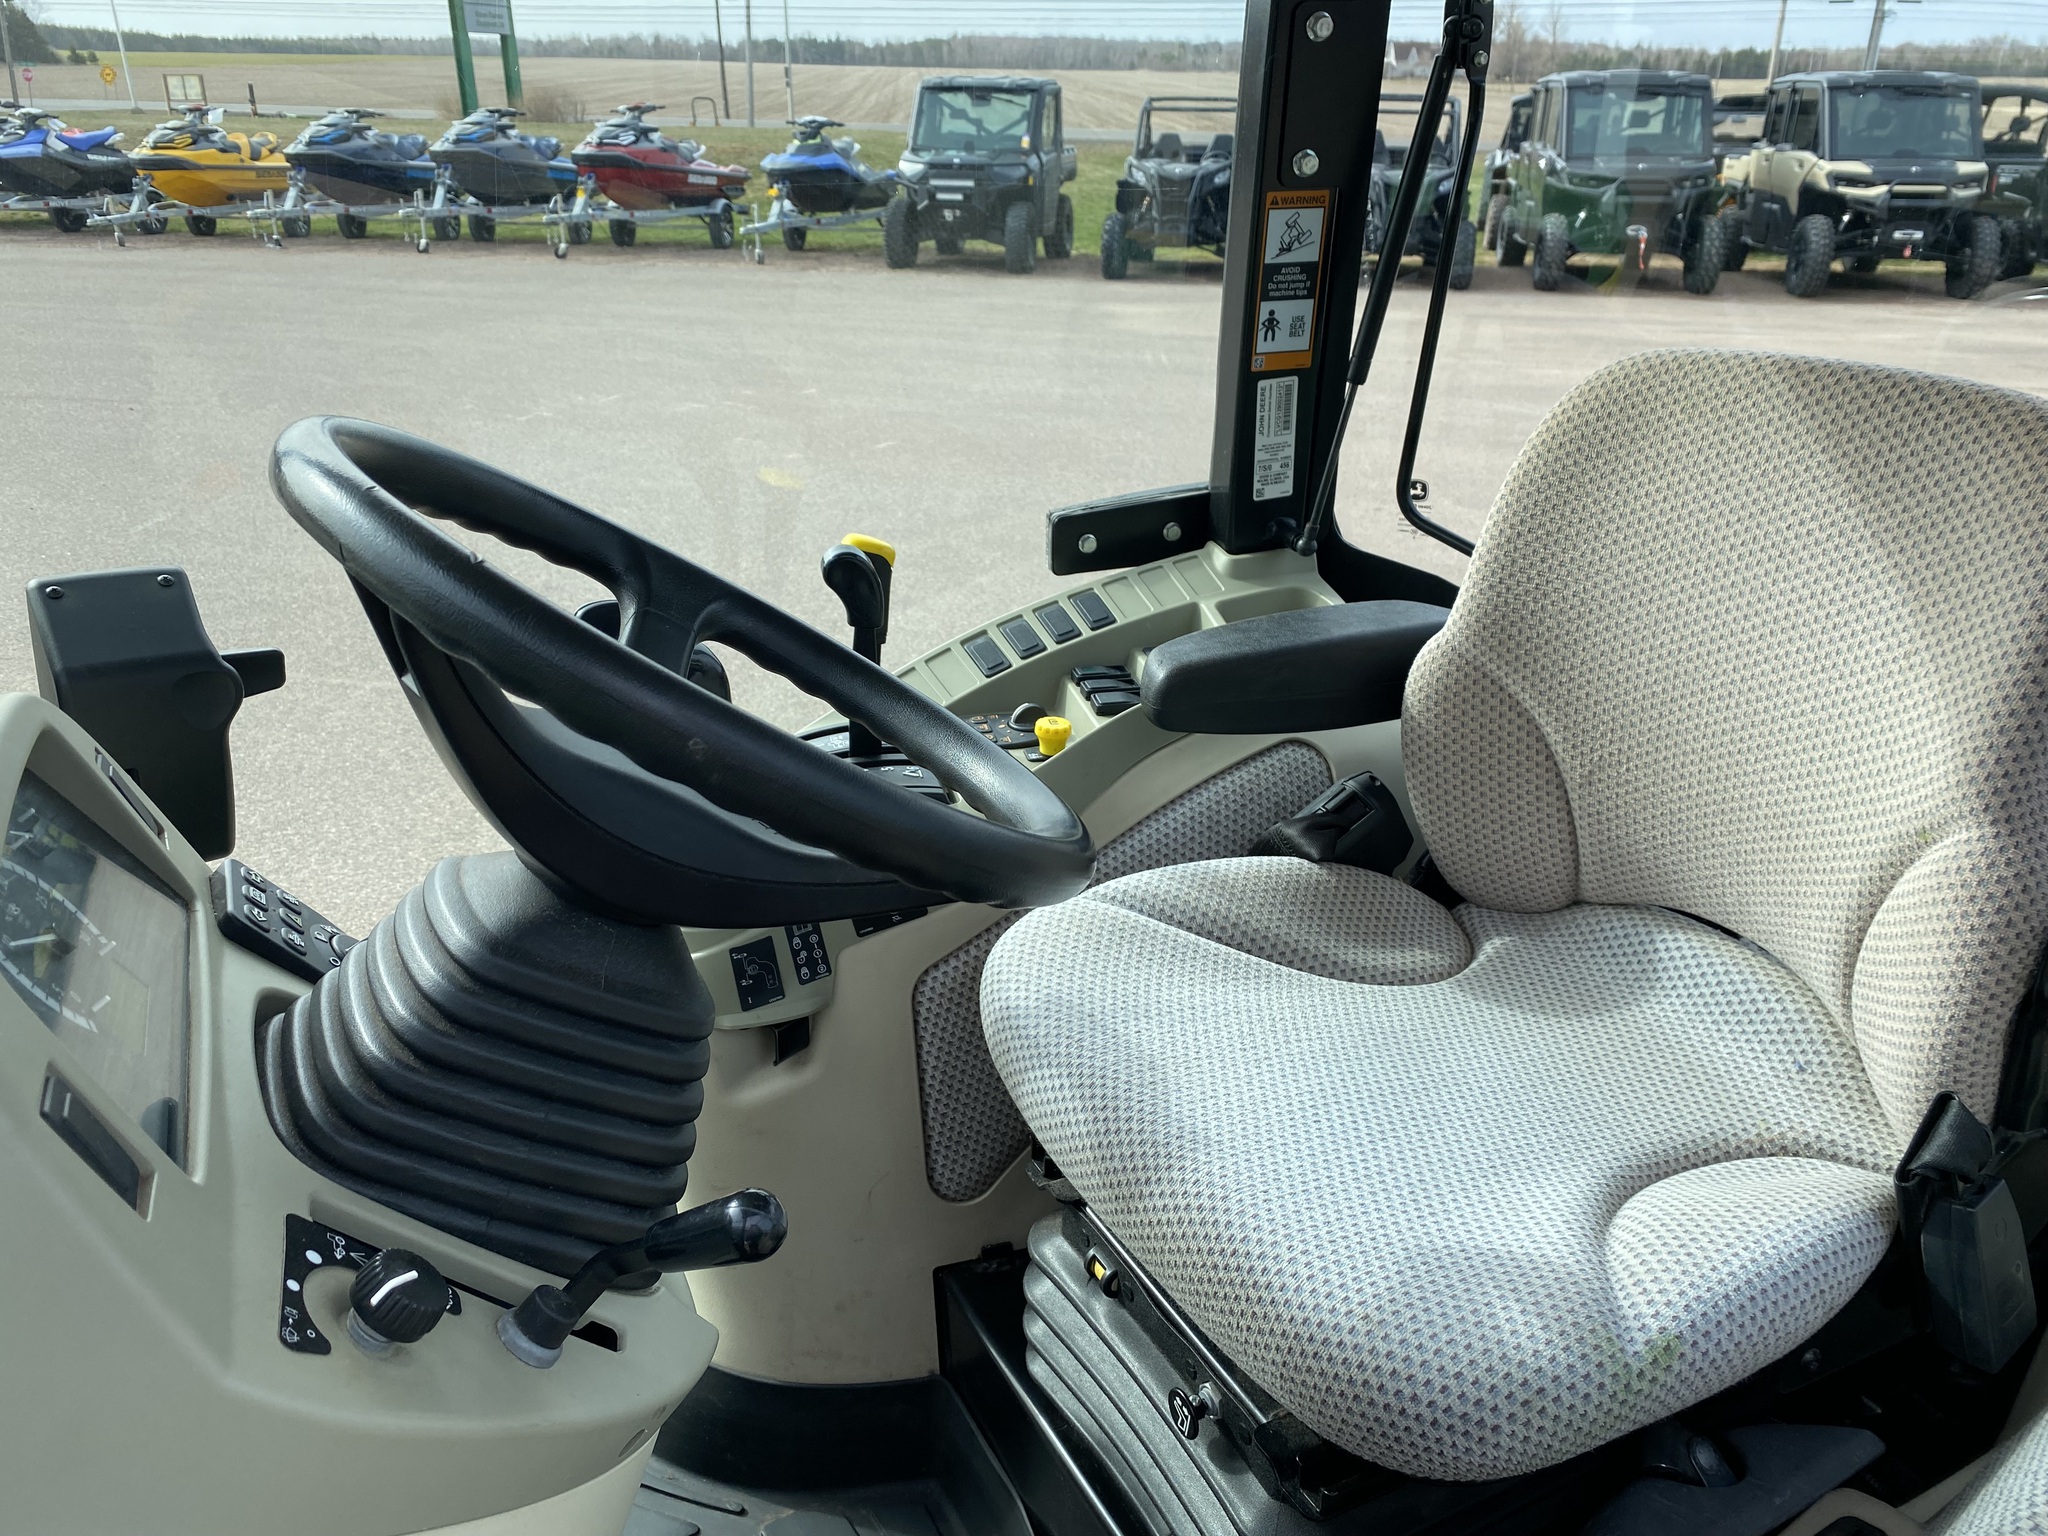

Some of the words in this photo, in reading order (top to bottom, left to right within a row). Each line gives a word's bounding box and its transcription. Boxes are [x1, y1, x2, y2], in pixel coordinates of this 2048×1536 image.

[1280, 195, 1326, 206] WARNING
[1273, 274, 1307, 282] CRUSHING
[1289, 282, 1305, 290] jump
[1296, 289, 1308, 297] tips
[1292, 315, 1305, 323] USE
[1290, 322, 1306, 330] SEAT
[1289, 330, 1305, 338] BELT
